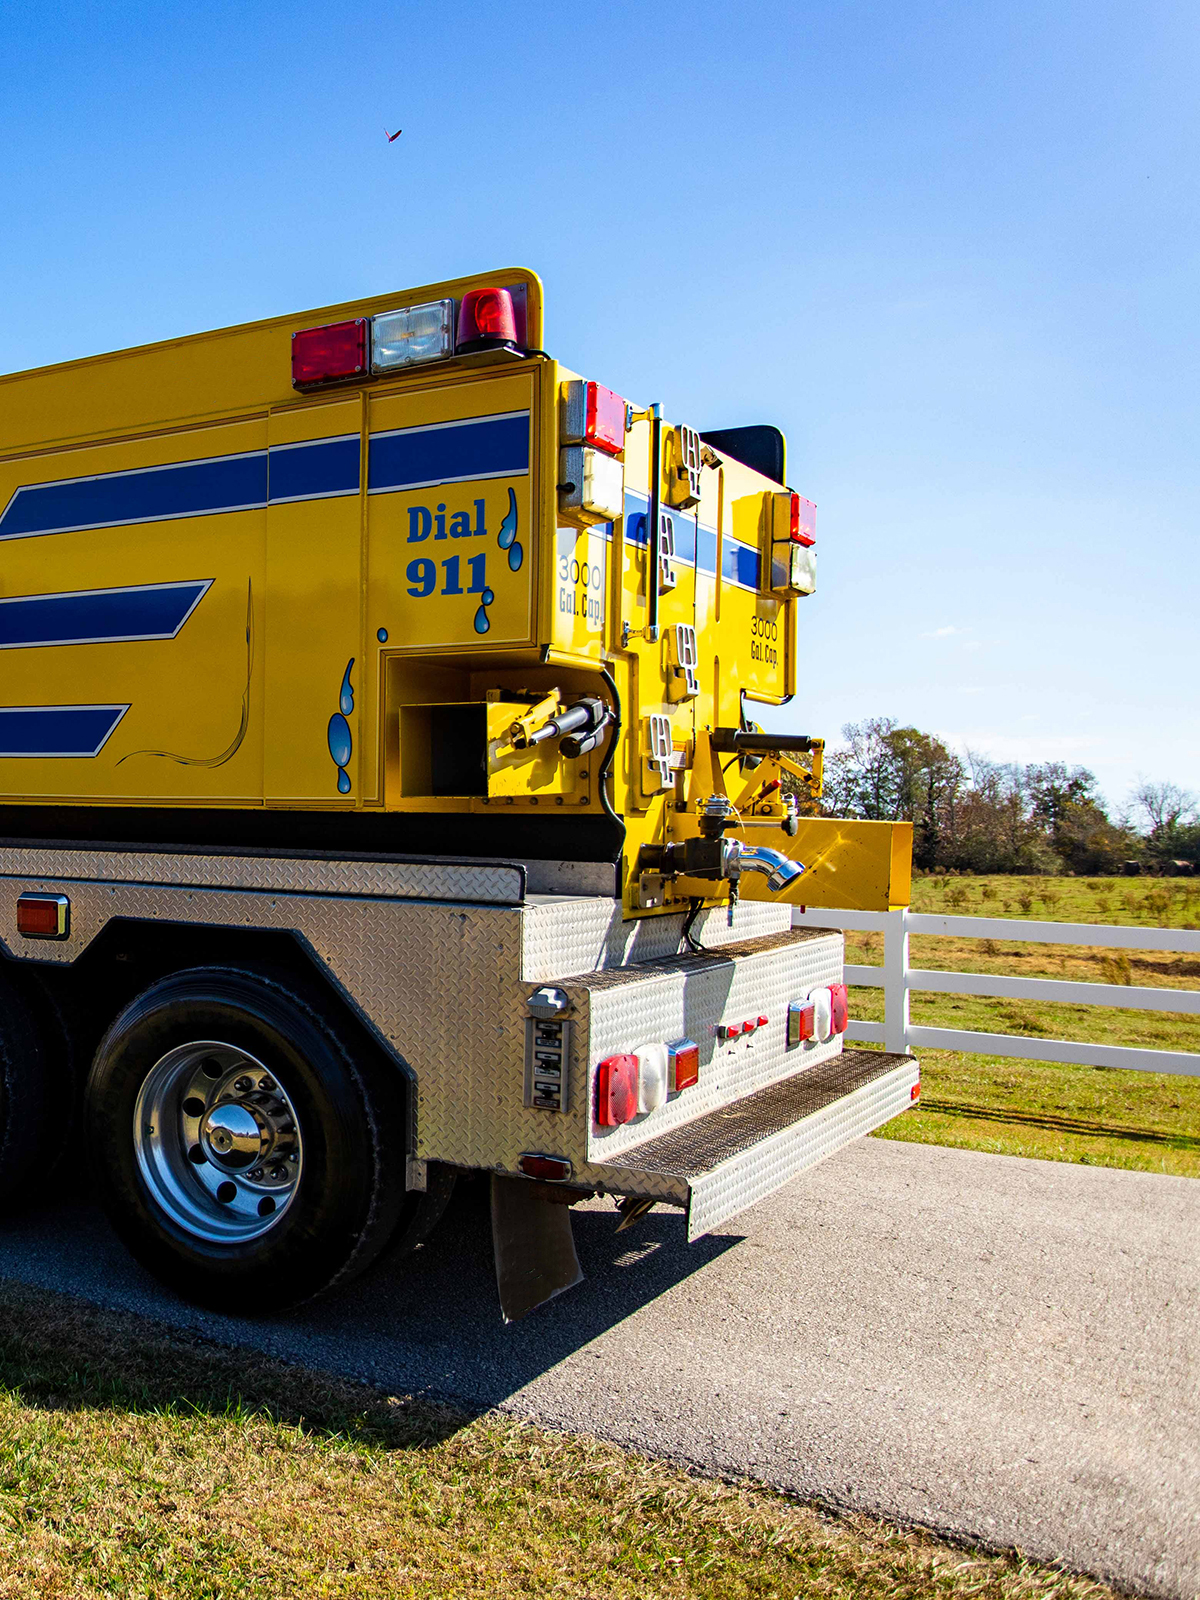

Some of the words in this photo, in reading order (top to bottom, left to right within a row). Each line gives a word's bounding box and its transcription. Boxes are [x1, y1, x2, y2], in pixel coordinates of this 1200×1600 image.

[406, 498, 488, 543] Dial
[406, 552, 490, 598] 911
[559, 554, 601, 591] 3000
[559, 586, 579, 617] Gal.
[581, 593, 605, 626] Cap.
[751, 615, 778, 642] 3000
[751, 640, 764, 662] Gal.
[765, 644, 779, 669] Cap.
